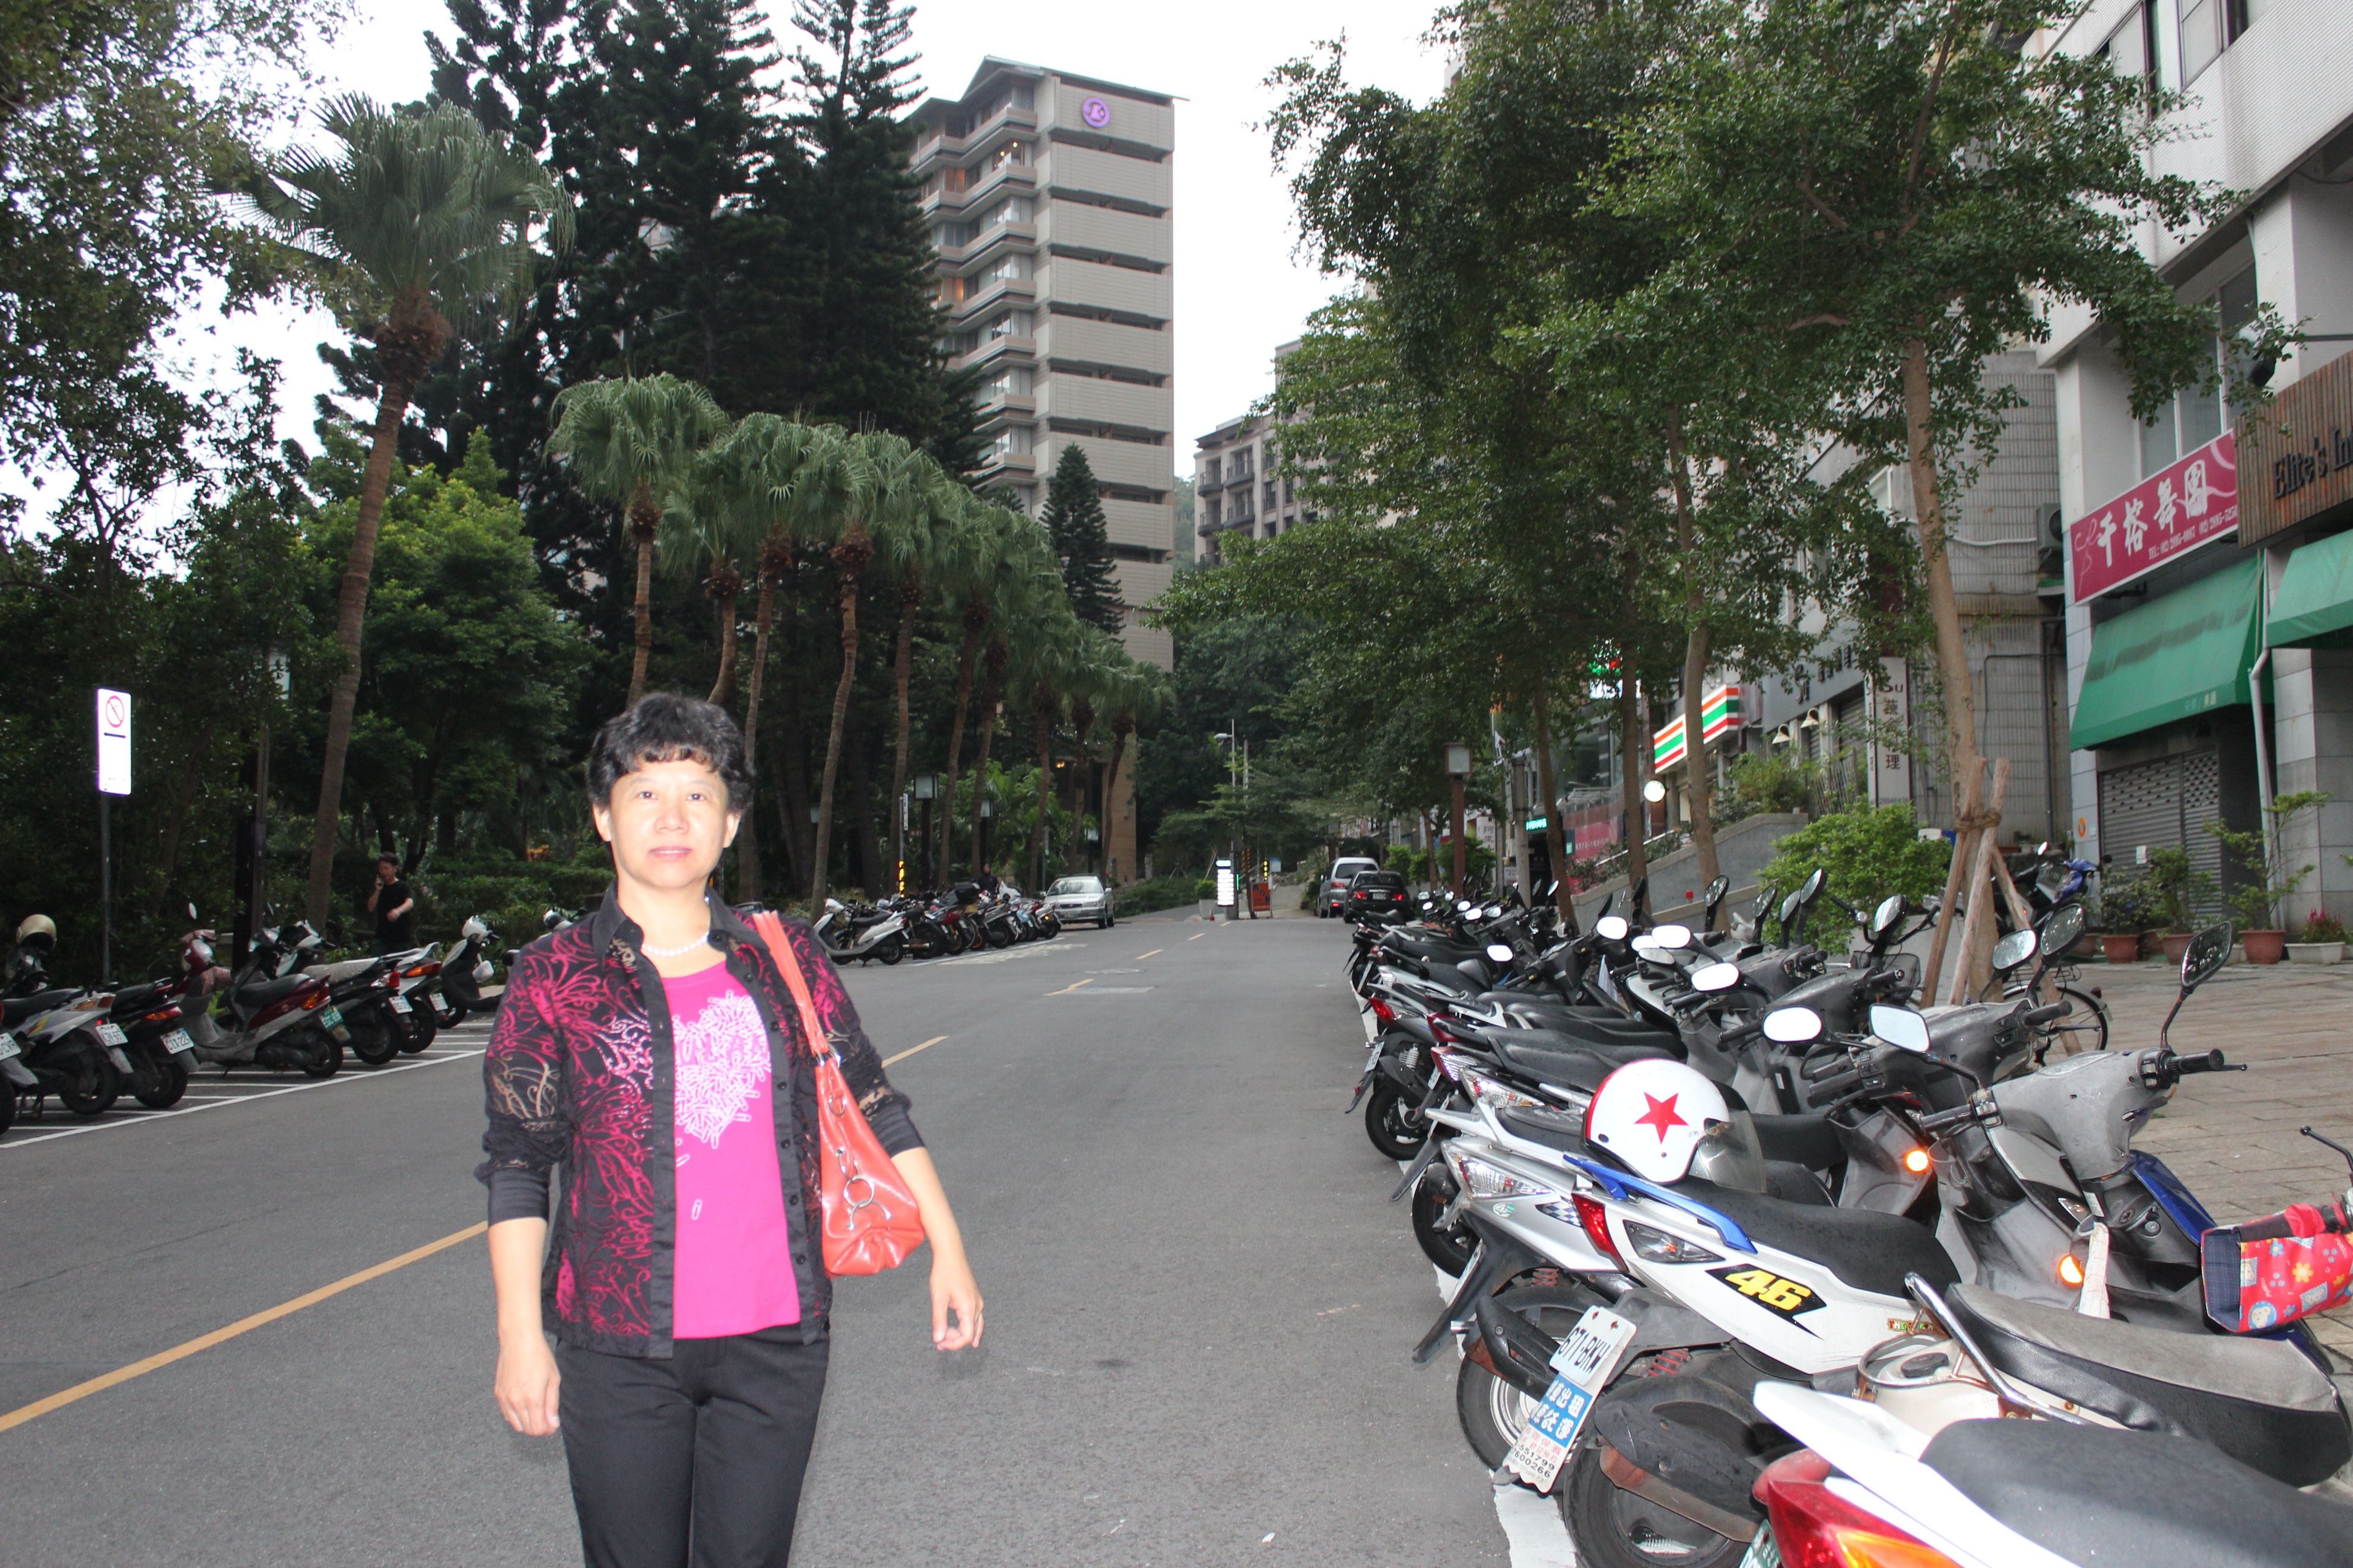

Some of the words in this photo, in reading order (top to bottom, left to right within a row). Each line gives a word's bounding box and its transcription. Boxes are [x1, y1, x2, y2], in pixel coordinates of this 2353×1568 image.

[2274, 436, 2328, 500] Elite's
[1725, 1270, 1812, 1311] 46
[1888, 1319, 1907, 1331] THE
[1558, 1327, 1611, 1373] 671-BKW
